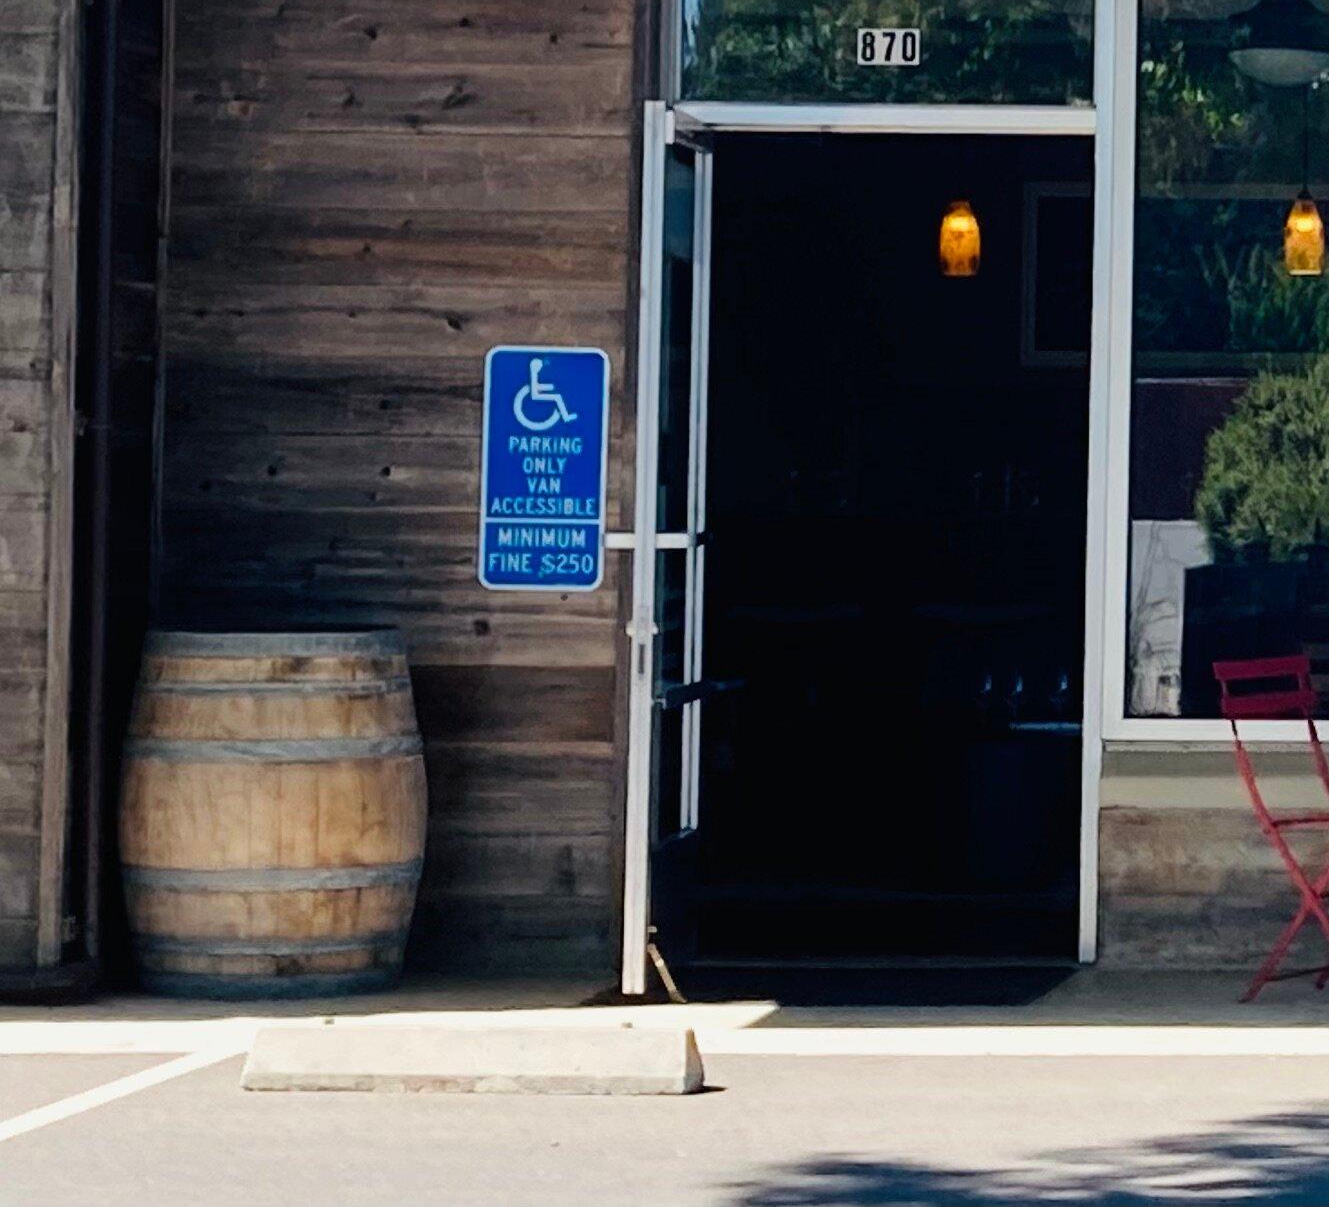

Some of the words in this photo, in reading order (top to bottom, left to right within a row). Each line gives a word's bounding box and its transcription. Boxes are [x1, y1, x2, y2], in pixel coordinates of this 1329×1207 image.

[861, 31, 917, 62] 870
[509, 436, 583, 453] PARKING
[523, 457, 567, 474] ONLY
[527, 478, 561, 493] VAN
[491, 498, 595, 515] ACCESSIBLE
[498, 529, 586, 548] MINIMUM
[488, 553, 533, 573] FINE
[540, 553, 594, 575] $250
